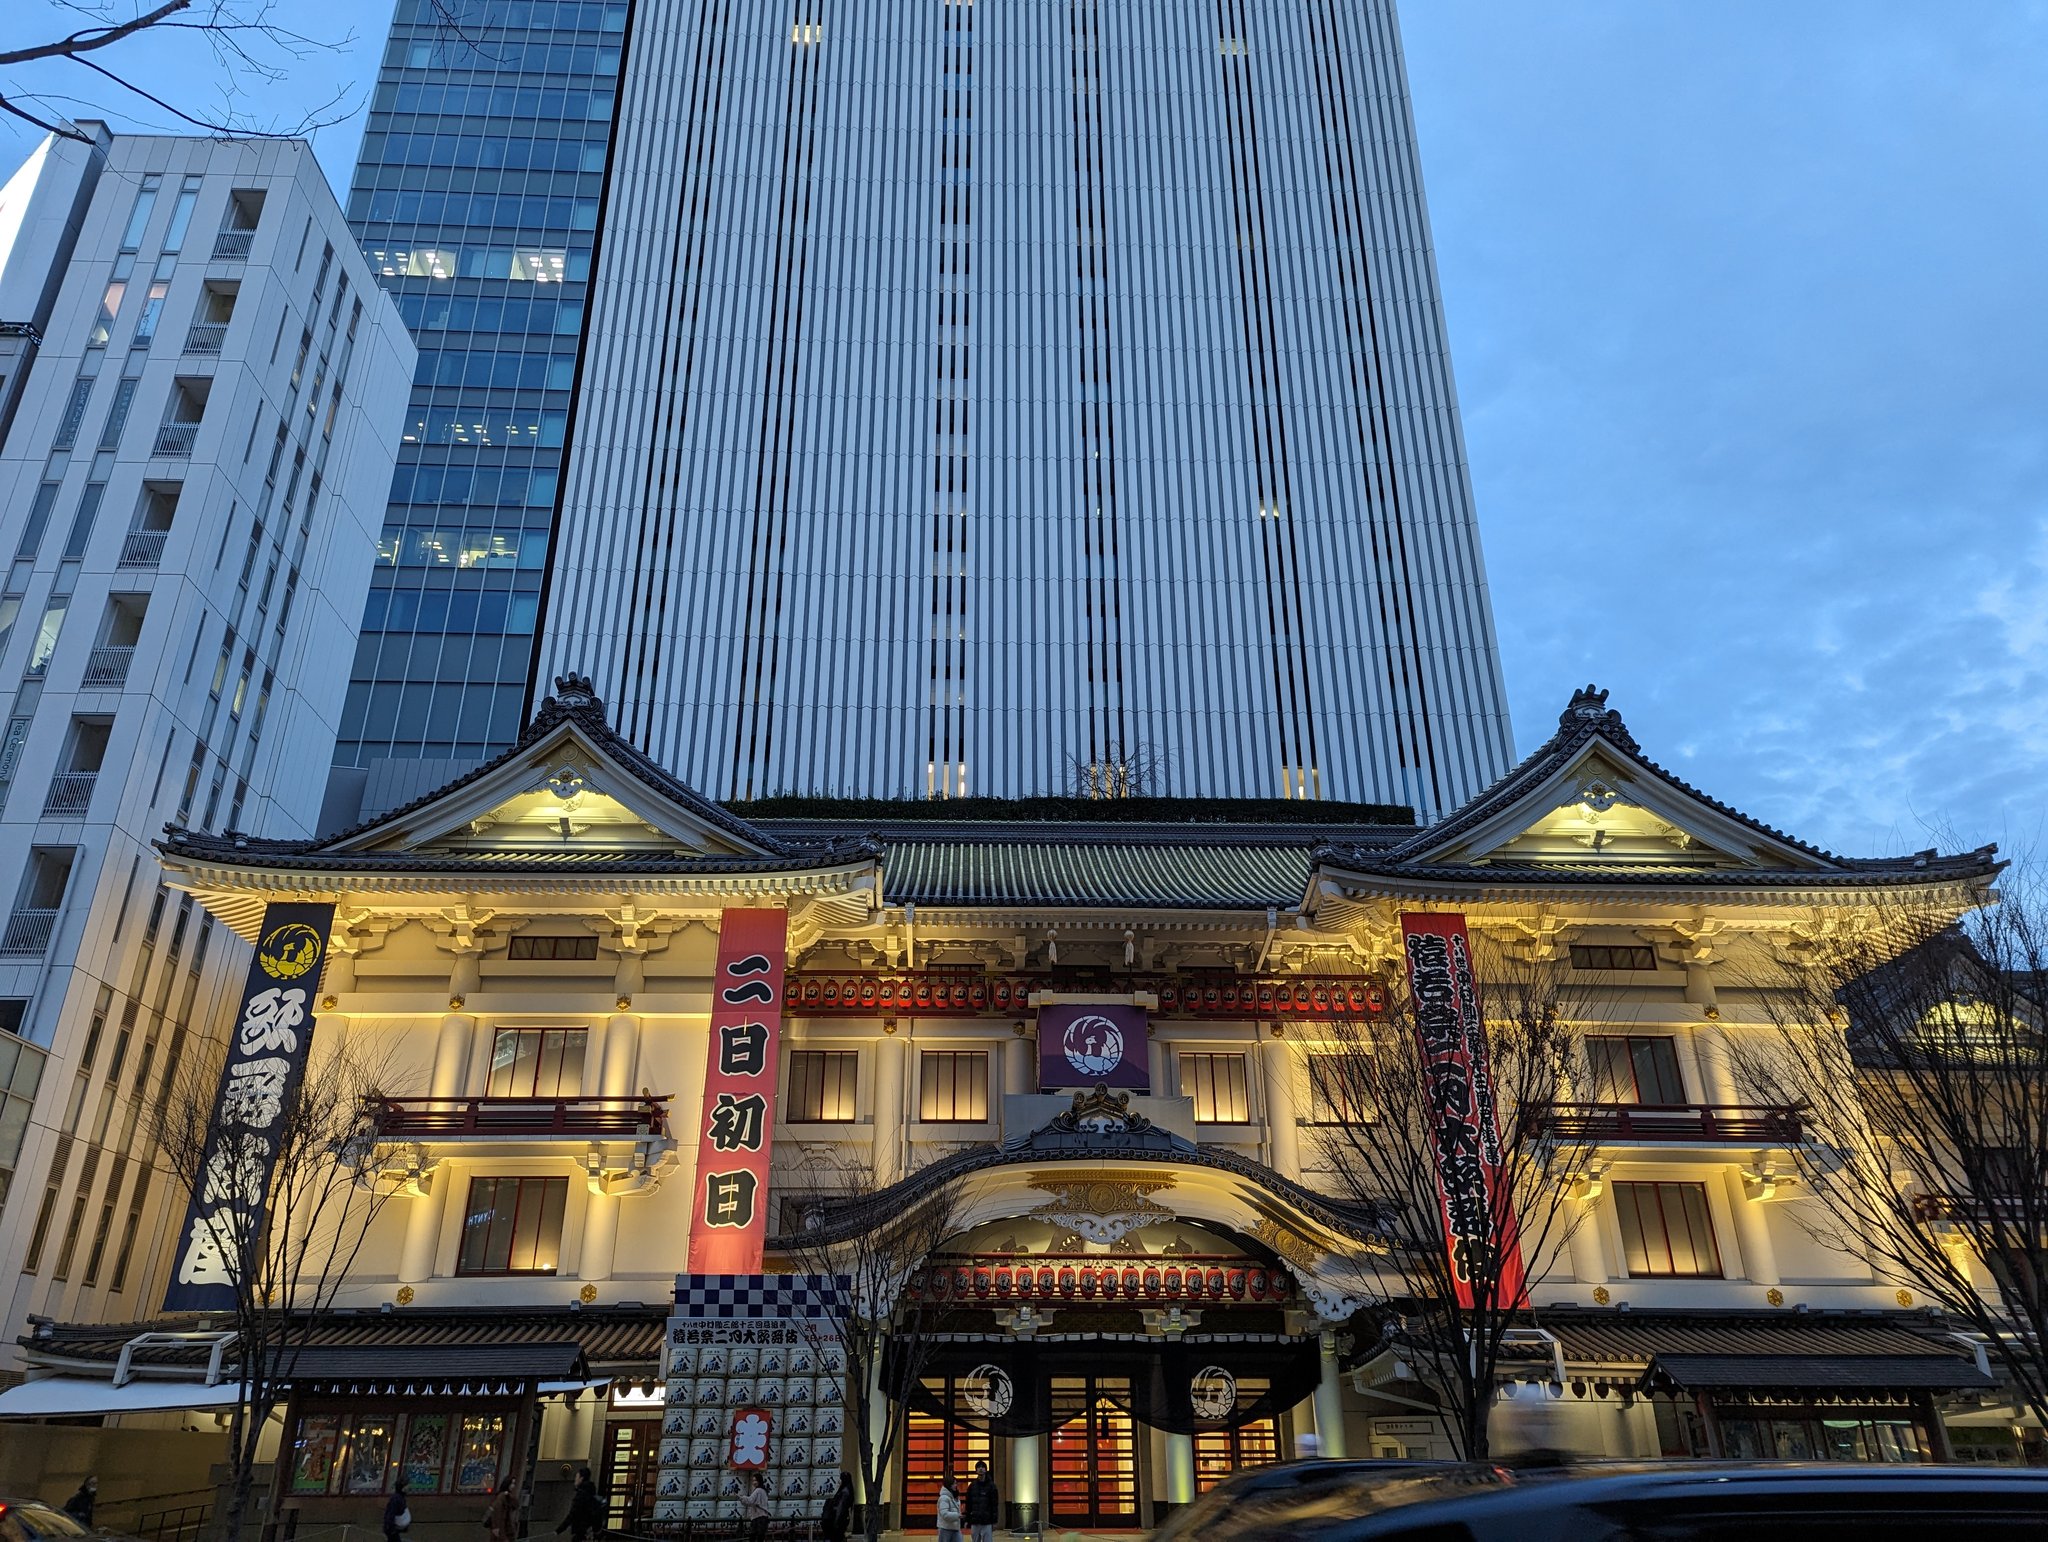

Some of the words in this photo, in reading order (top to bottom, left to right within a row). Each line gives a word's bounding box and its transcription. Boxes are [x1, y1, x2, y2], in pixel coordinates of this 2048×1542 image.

[13, 721, 25, 736] Tea
[0, 737, 20, 781] Ceremony
[704, 953, 774, 1230] 二日初日
[178, 987, 306, 1288] 歌舞伎座
[672, 1328, 798, 1345] 猿若祭二月大歌舞伎
